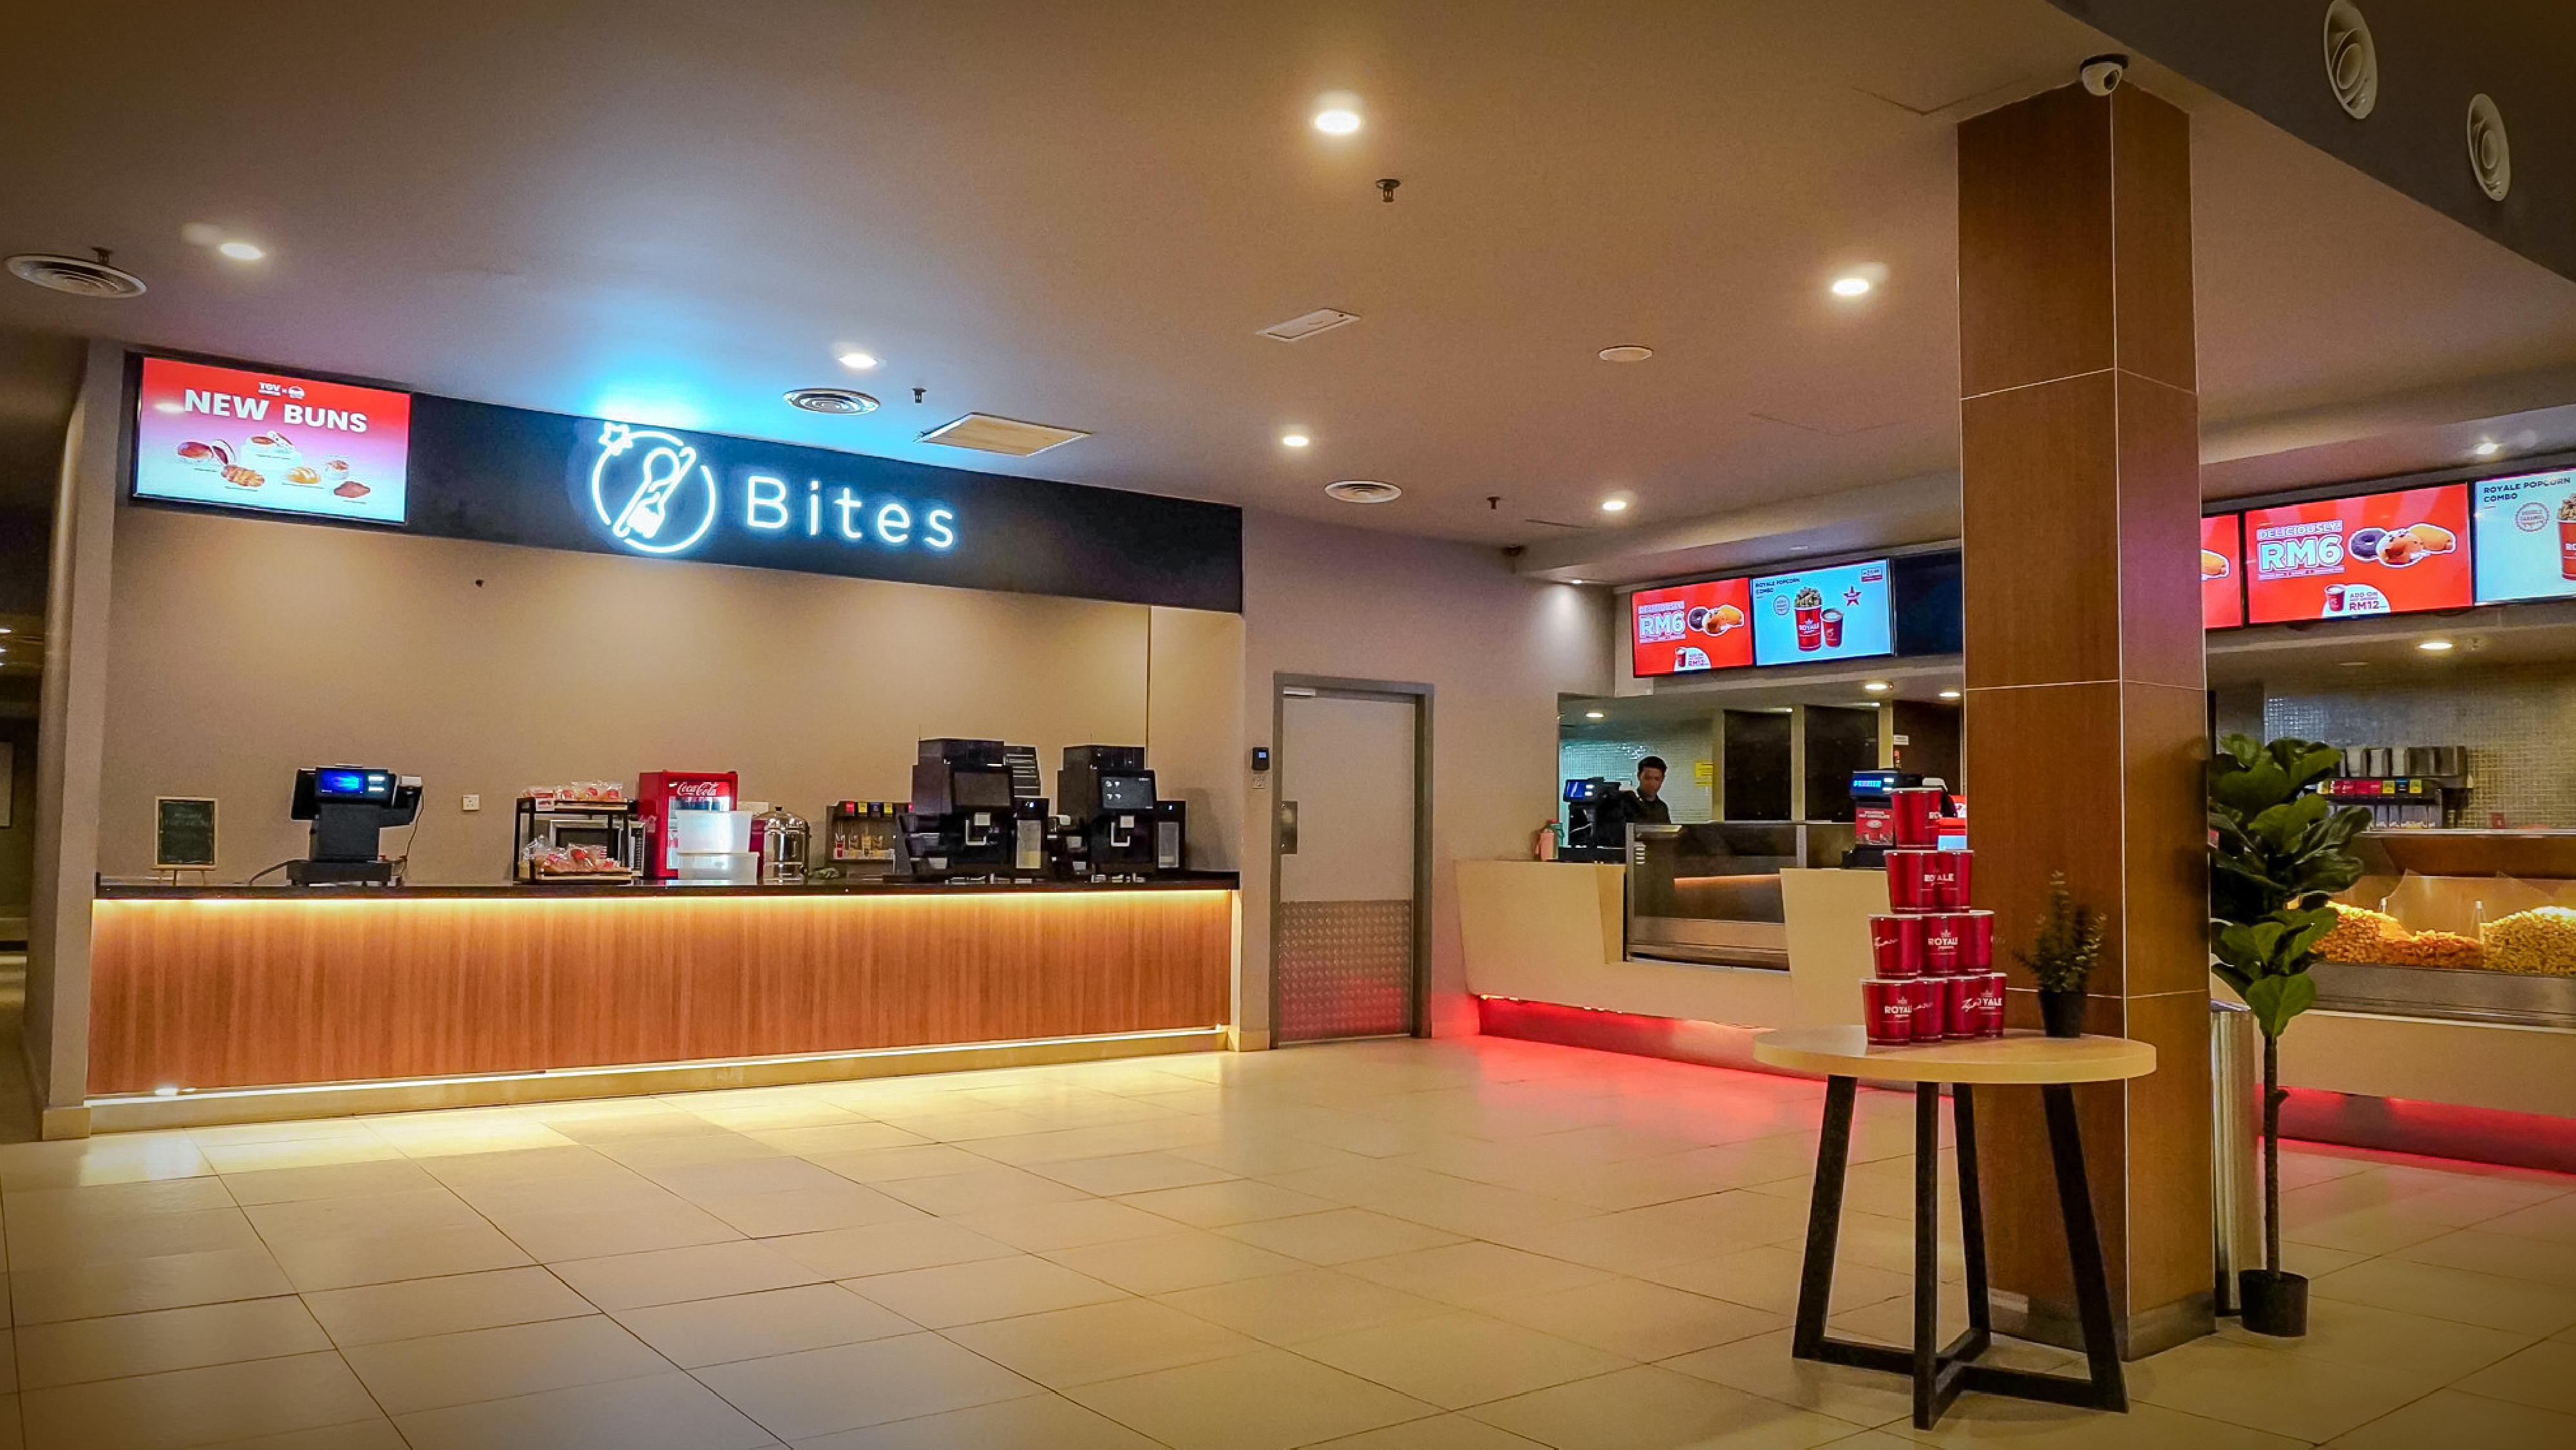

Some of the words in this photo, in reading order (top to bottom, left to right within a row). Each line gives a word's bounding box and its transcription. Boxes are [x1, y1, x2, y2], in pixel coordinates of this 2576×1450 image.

[259, 381, 281, 392] TGV
[185, 389, 270, 421] NEW
[284, 403, 367, 433] BUNS
[2484, 484, 2521, 493] ROYALE
[2523, 477, 2571, 488] POPCORN
[2484, 493, 2518, 502] COMBO
[746, 475, 955, 548] Bites
[2261, 535, 2342, 570] RM6
[2349, 600, 2380, 611] RM12
[1640, 612, 1685, 635] RM6
